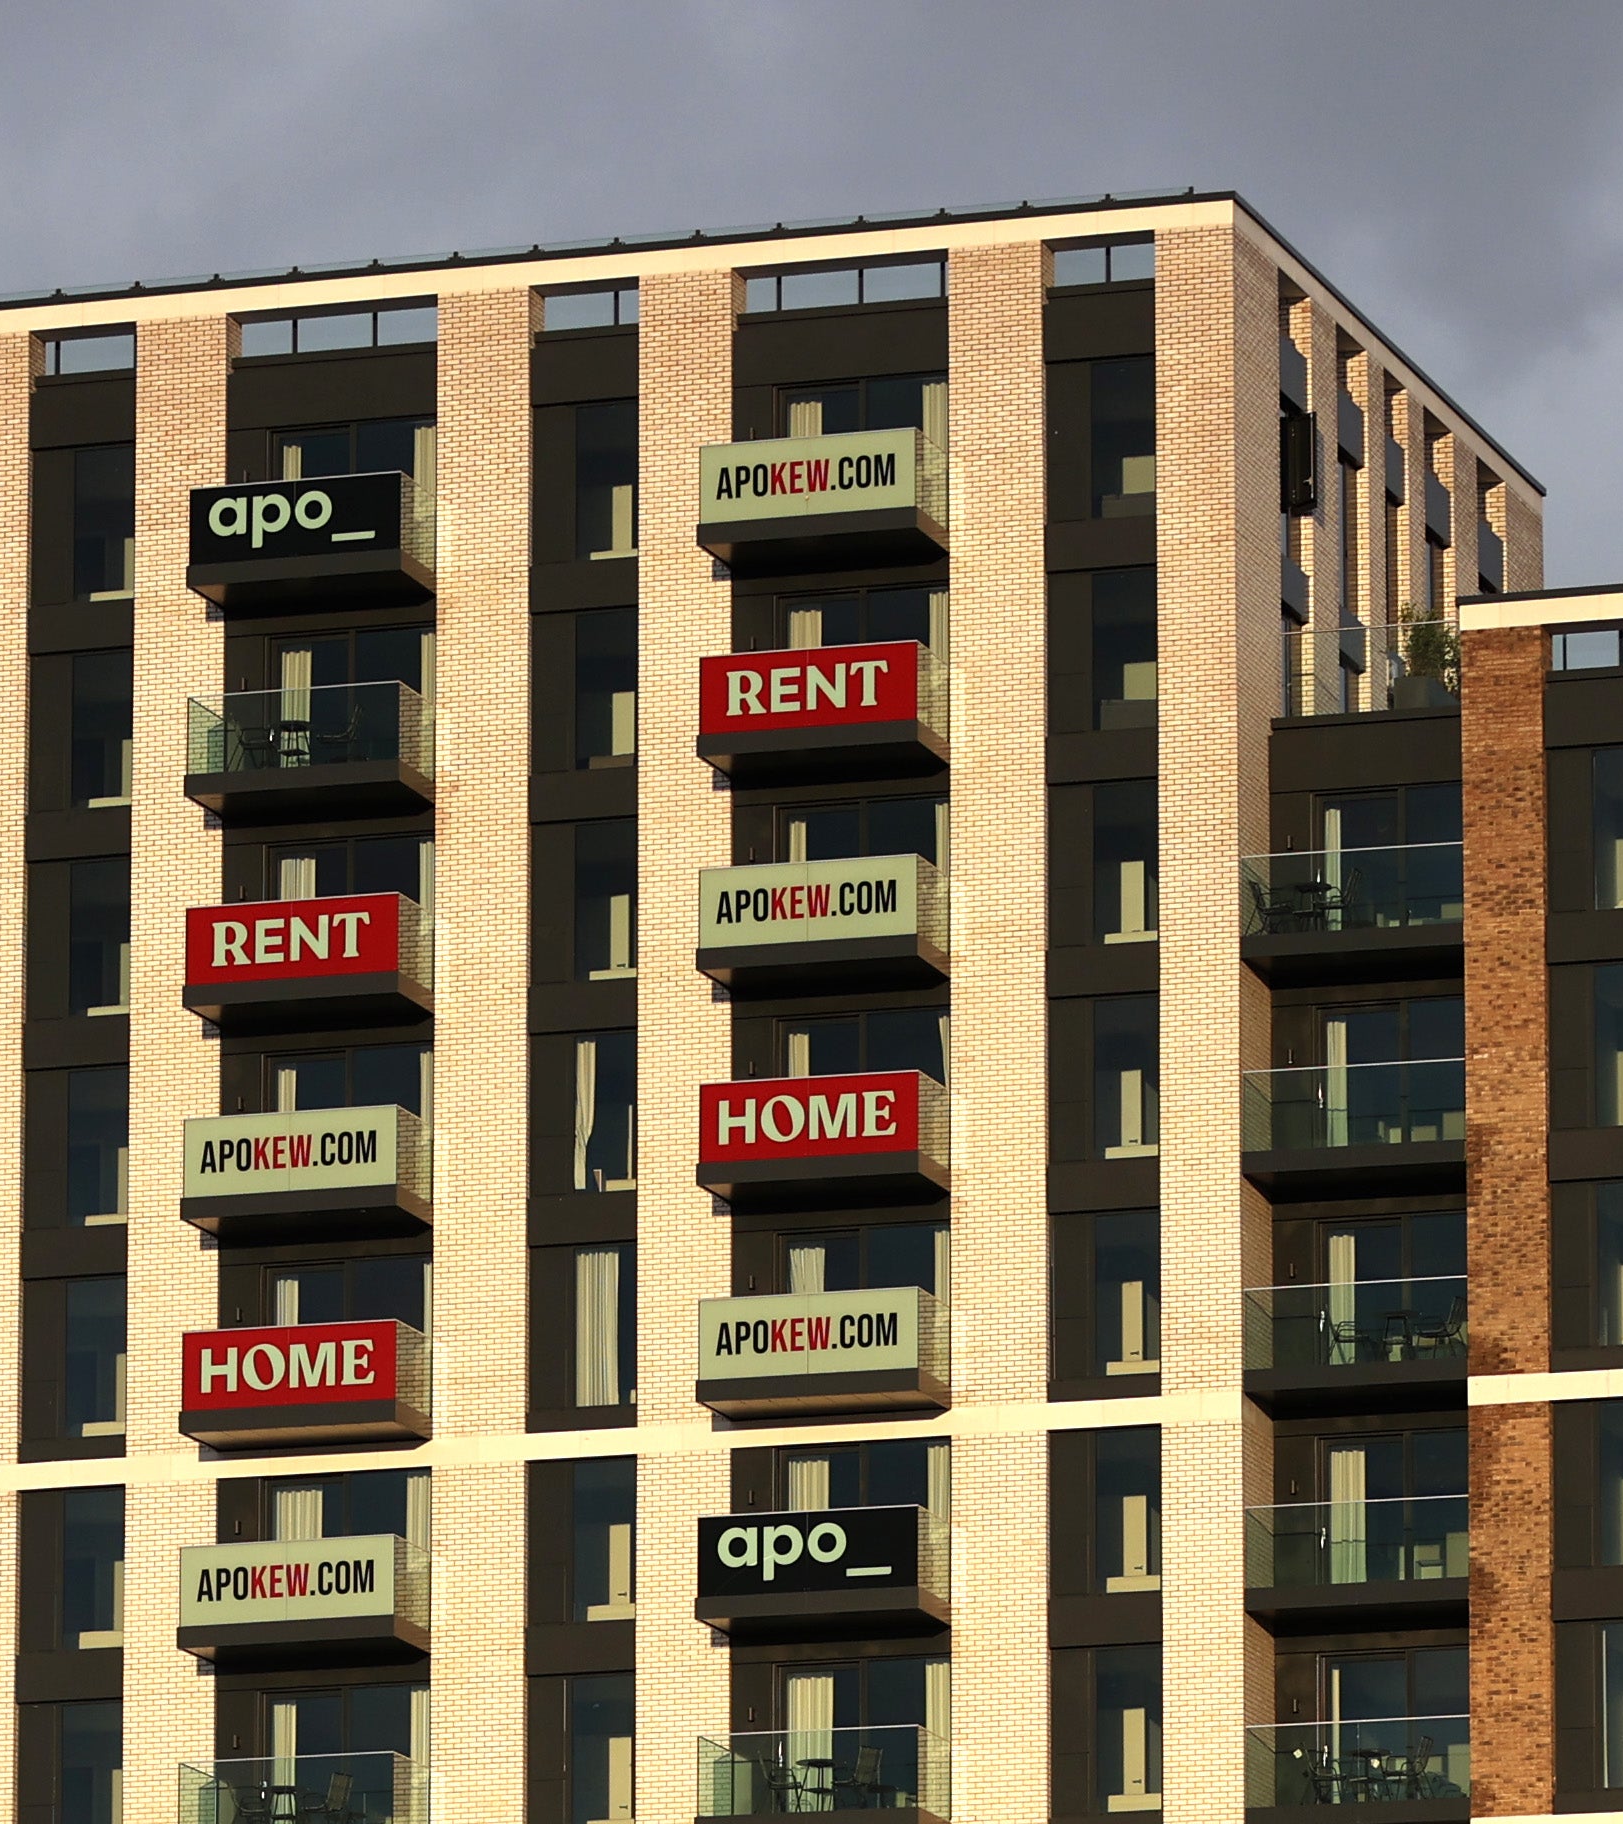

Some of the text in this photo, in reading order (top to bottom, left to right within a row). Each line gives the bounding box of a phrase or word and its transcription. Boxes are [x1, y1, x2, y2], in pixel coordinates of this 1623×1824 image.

[716, 452, 896, 500] APOKEW.COM
[725, 660, 888, 717] RENT
[715, 879, 897, 924] APOKEW.COM
[211, 911, 370, 967] RENT
[716, 1090, 898, 1146] HOME
[200, 1129, 377, 1175] APOKEW.COM
[714, 1312, 898, 1357] APOKEW.COM
[199, 1338, 375, 1394] HOME
[196, 1558, 375, 1602] APOKEW.COM
